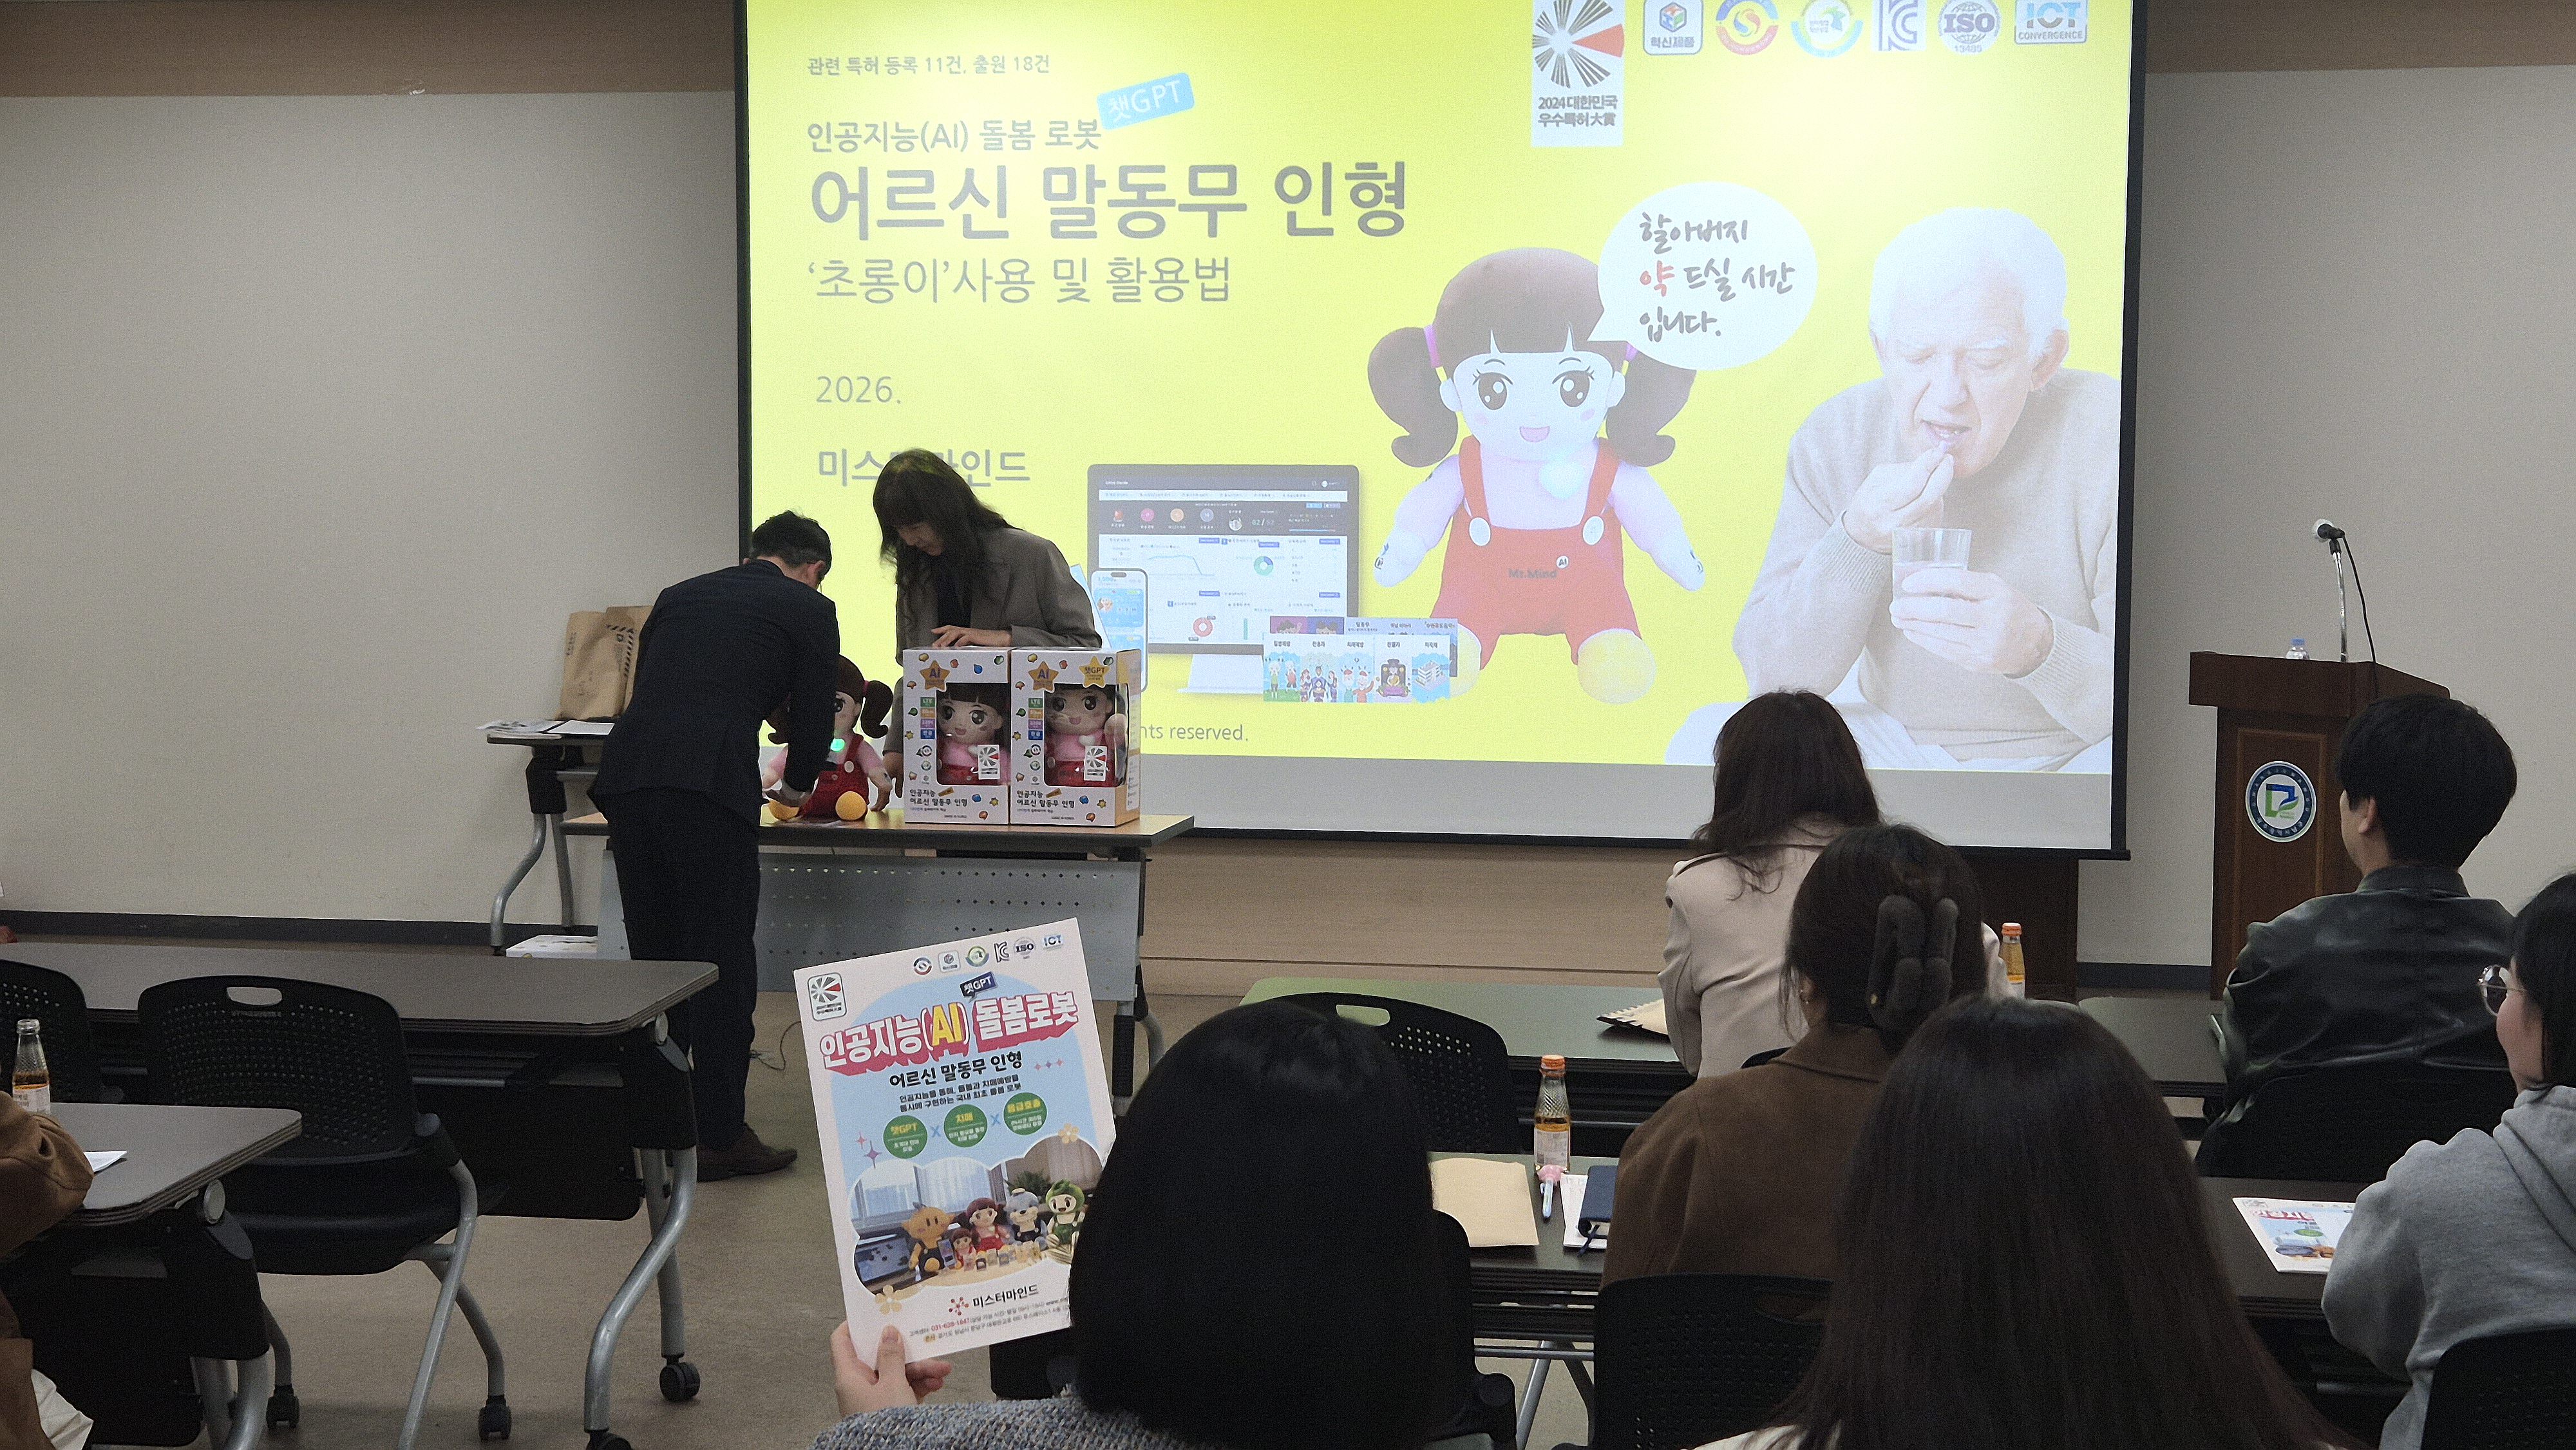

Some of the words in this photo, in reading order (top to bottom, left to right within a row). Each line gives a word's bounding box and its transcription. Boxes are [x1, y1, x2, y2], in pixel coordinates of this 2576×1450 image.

[1944, 13, 1994, 32] ISO
[2018, 31, 2082, 40] CONVERGENCE
[808, 57, 840, 75] 관련
[846, 57, 879, 75] 특허
[884, 57, 918, 74] 등록
[925, 56, 967, 74] 11건,
[973, 55, 1006, 73] 출원
[1014, 55, 1050, 73] 18건
[1108, 79, 1182, 120] 챗GPT
[1538, 95, 1618, 109] 2024대한민국
[808, 120, 969, 153] 인공지능(AI)
[979, 120, 1036, 151] 돌봄
[1045, 119, 1102, 151] 로봇
[811, 165, 1009, 240] 어르신
[1043, 164, 1247, 239] 말동무
[1274, 161, 1405, 238] 인형
[1639, 212, 1748, 254] 할아버지
[1054, 258, 1090, 303] 및
[1106, 257, 1229, 304] 활용법
[1640, 260, 1675, 297] 약
[1683, 258, 1736, 302] 드실
[1741, 261, 1795, 294] 시간
[1639, 306, 1721, 343] 입니다.
[815, 375, 902, 404] 2026.
[1508, 569, 1558, 579] Mr.Mind
[929, 669, 940, 678] AI
[1038, 669, 1049, 679] AI
[1170, 724, 1248, 741] reserved.
[1016, 944, 1034, 952] ISO
[1044, 935, 1062, 947] ICT
[963, 976, 992, 993] 챗GPT
[821, 1002, 970, 1064] 인공지능(AI)
[976, 992, 1077, 1040] 돌봄로봇
[889, 1068, 936, 1088] 어르신
[941, 1059, 987, 1082] 말동무
[990, 1051, 1023, 1073] 인형
[973, 1285, 1039, 1308] 미스터마인드
